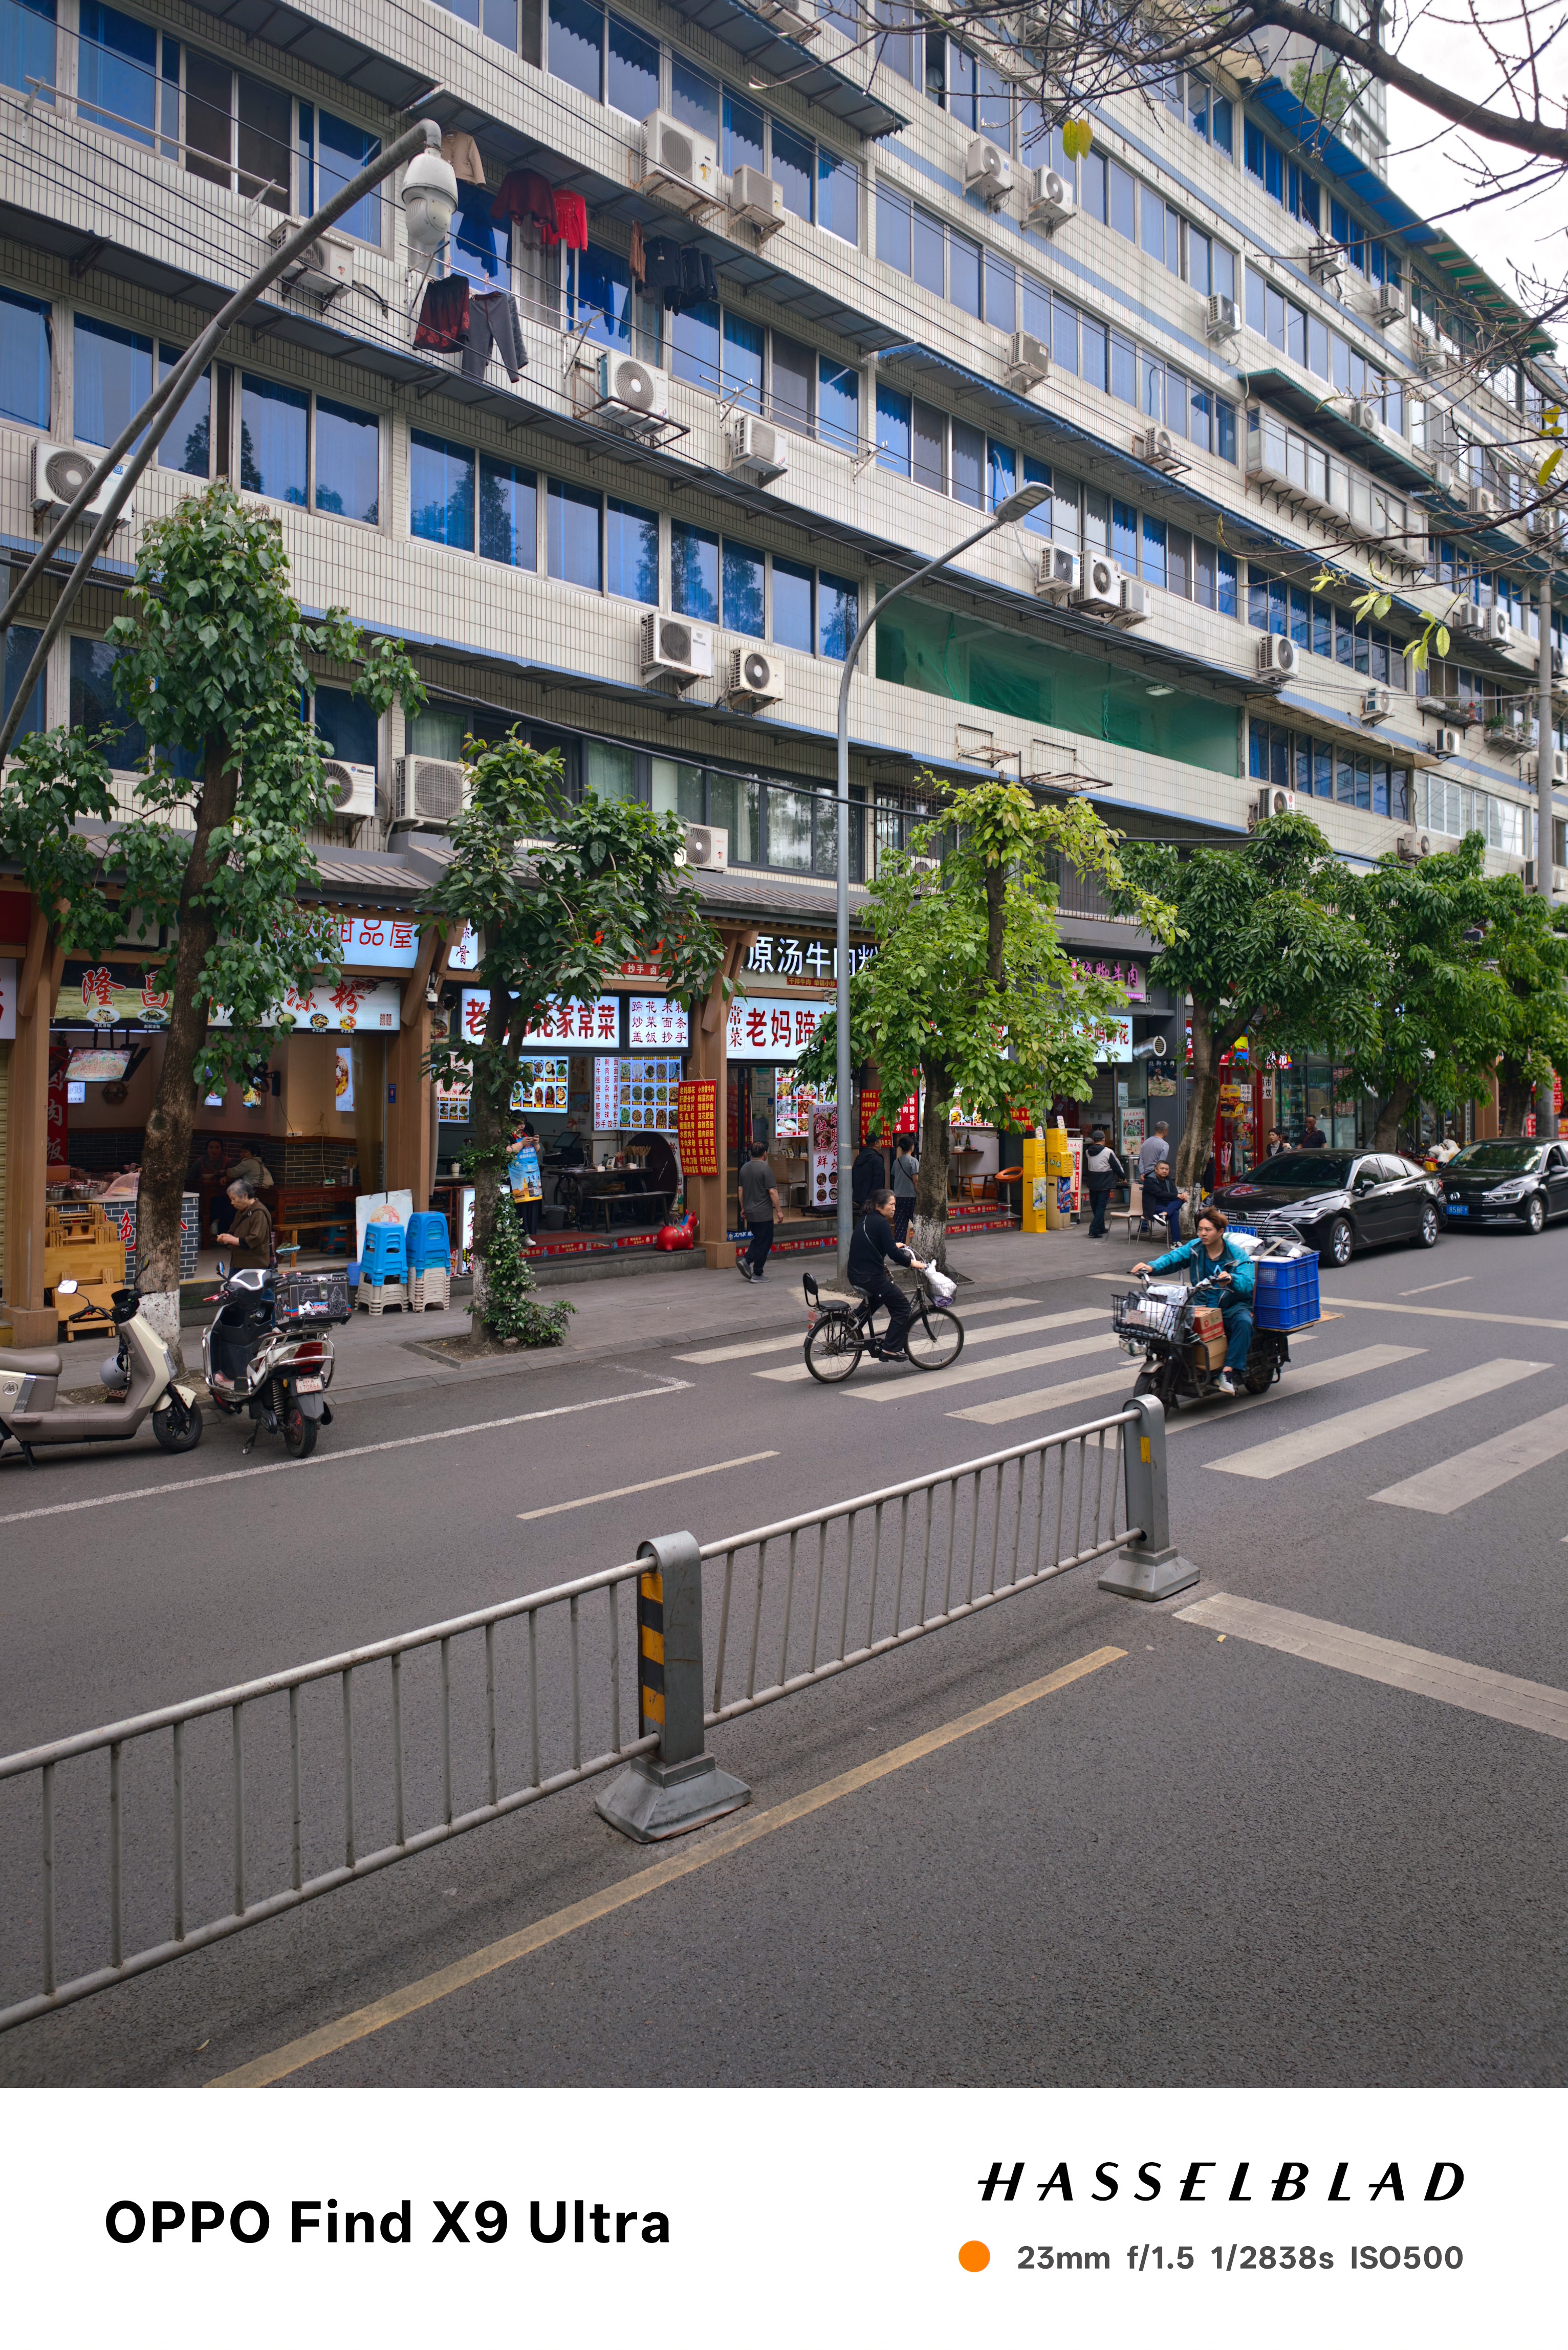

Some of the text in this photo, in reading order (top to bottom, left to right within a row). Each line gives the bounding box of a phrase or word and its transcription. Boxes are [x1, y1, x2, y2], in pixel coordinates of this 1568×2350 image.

[789, 977, 836, 988] 干拌牛肉 单锅小炒
[631, 1000, 657, 1013] 蹄花
[466, 998, 615, 1039] 老花家常菜
[631, 1016, 687, 1029] 炒菜 面条
[746, 1007, 827, 1048] 老妈蹄
[631, 1031, 687, 1043] 盖饭 抄手
[680, 1085, 714, 1094] 老妈蹄花 小炒黄牛肉
[1262, 1090, 1272, 1098] 饮
[679, 1113, 694, 1121] 毛血旺
